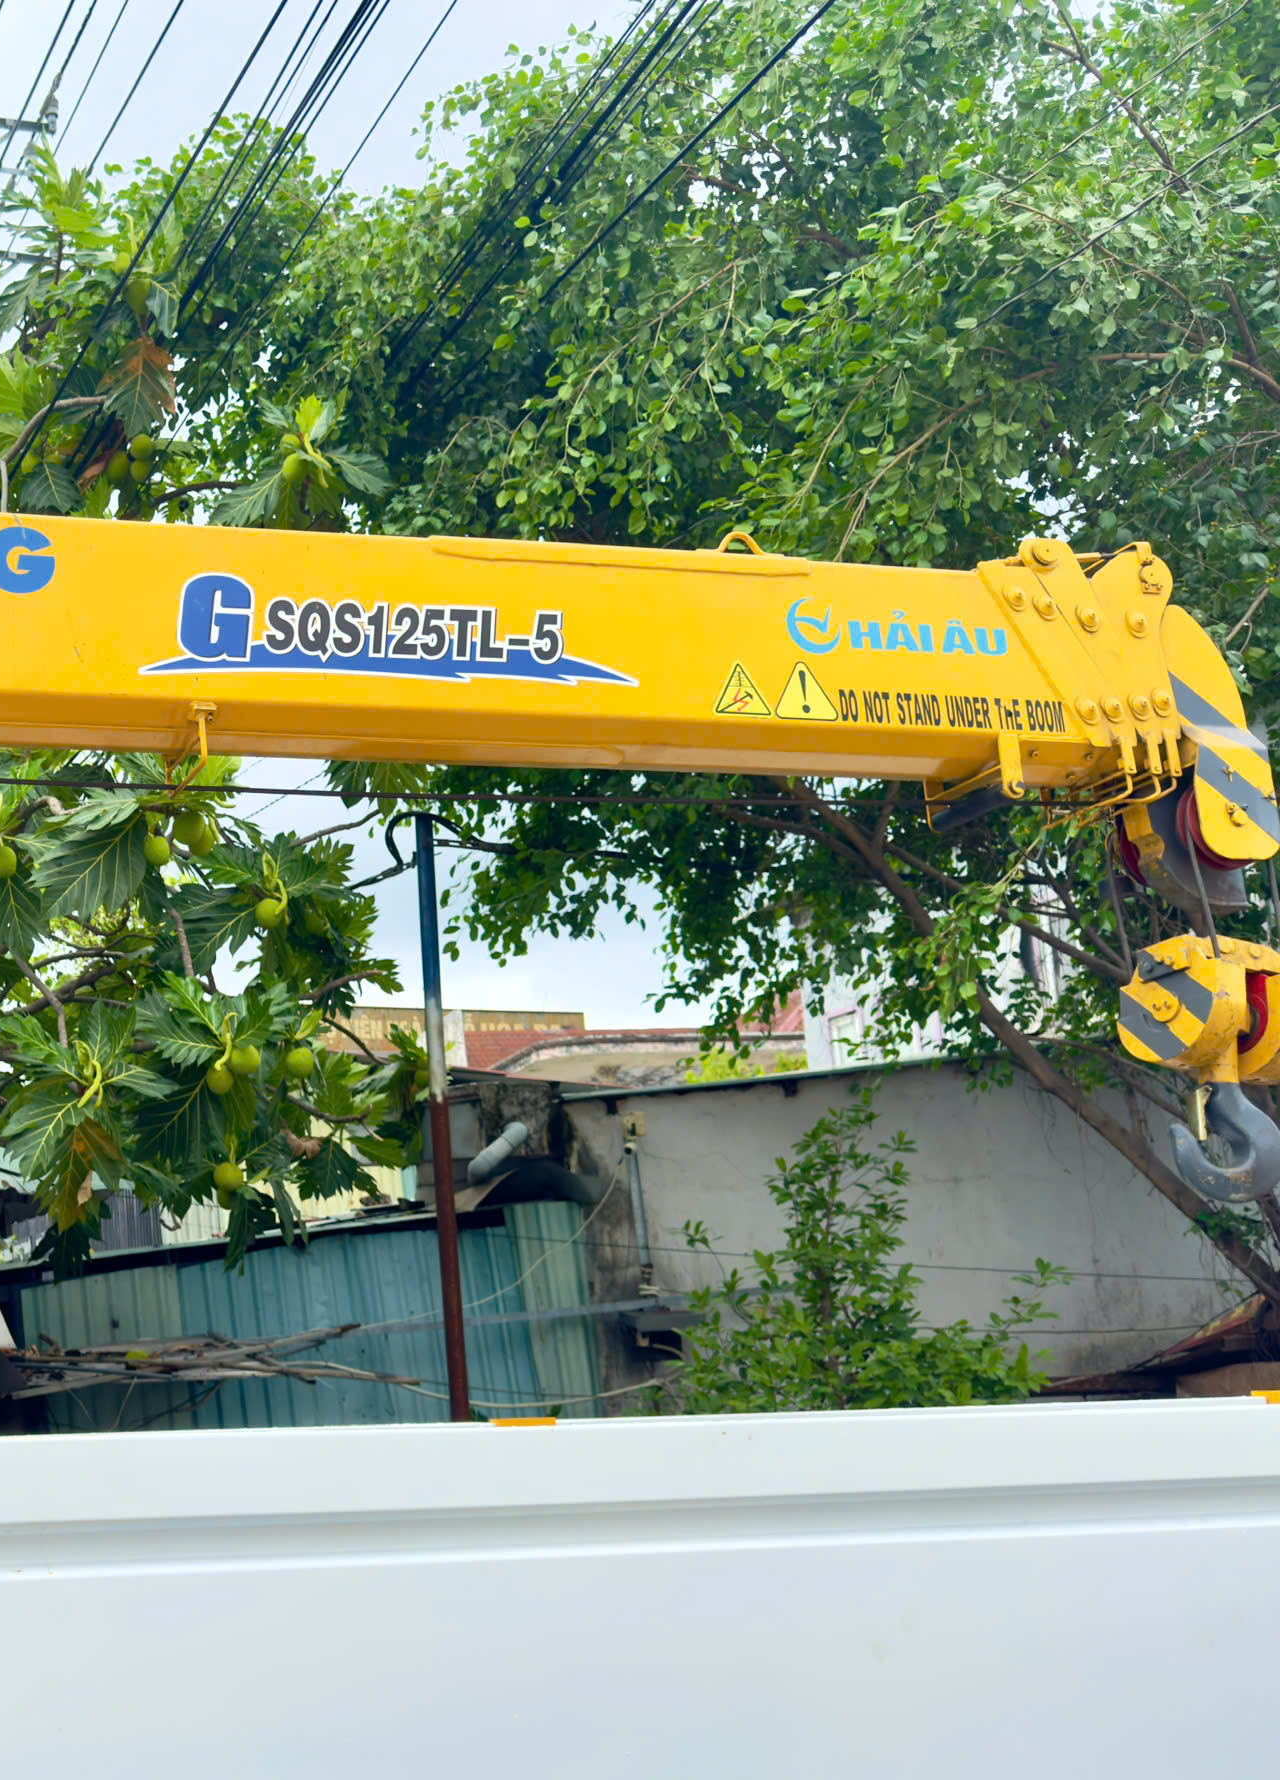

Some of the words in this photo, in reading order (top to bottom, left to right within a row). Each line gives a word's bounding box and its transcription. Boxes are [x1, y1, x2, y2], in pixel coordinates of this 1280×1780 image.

[180, 573, 253, 660] G
[265, 599, 563, 663] SQS125TL-5
[847, 610, 935, 653] HẢI
[942, 619, 1009, 656] ÂU
[838, 689, 859, 722] DO
[863, 691, 891, 724] NOT
[896, 692, 941, 727] STAND
[945, 695, 993, 729] UNDER
[995, 698, 1023, 731] THE
[1026, 700, 1066, 733] BOOM
